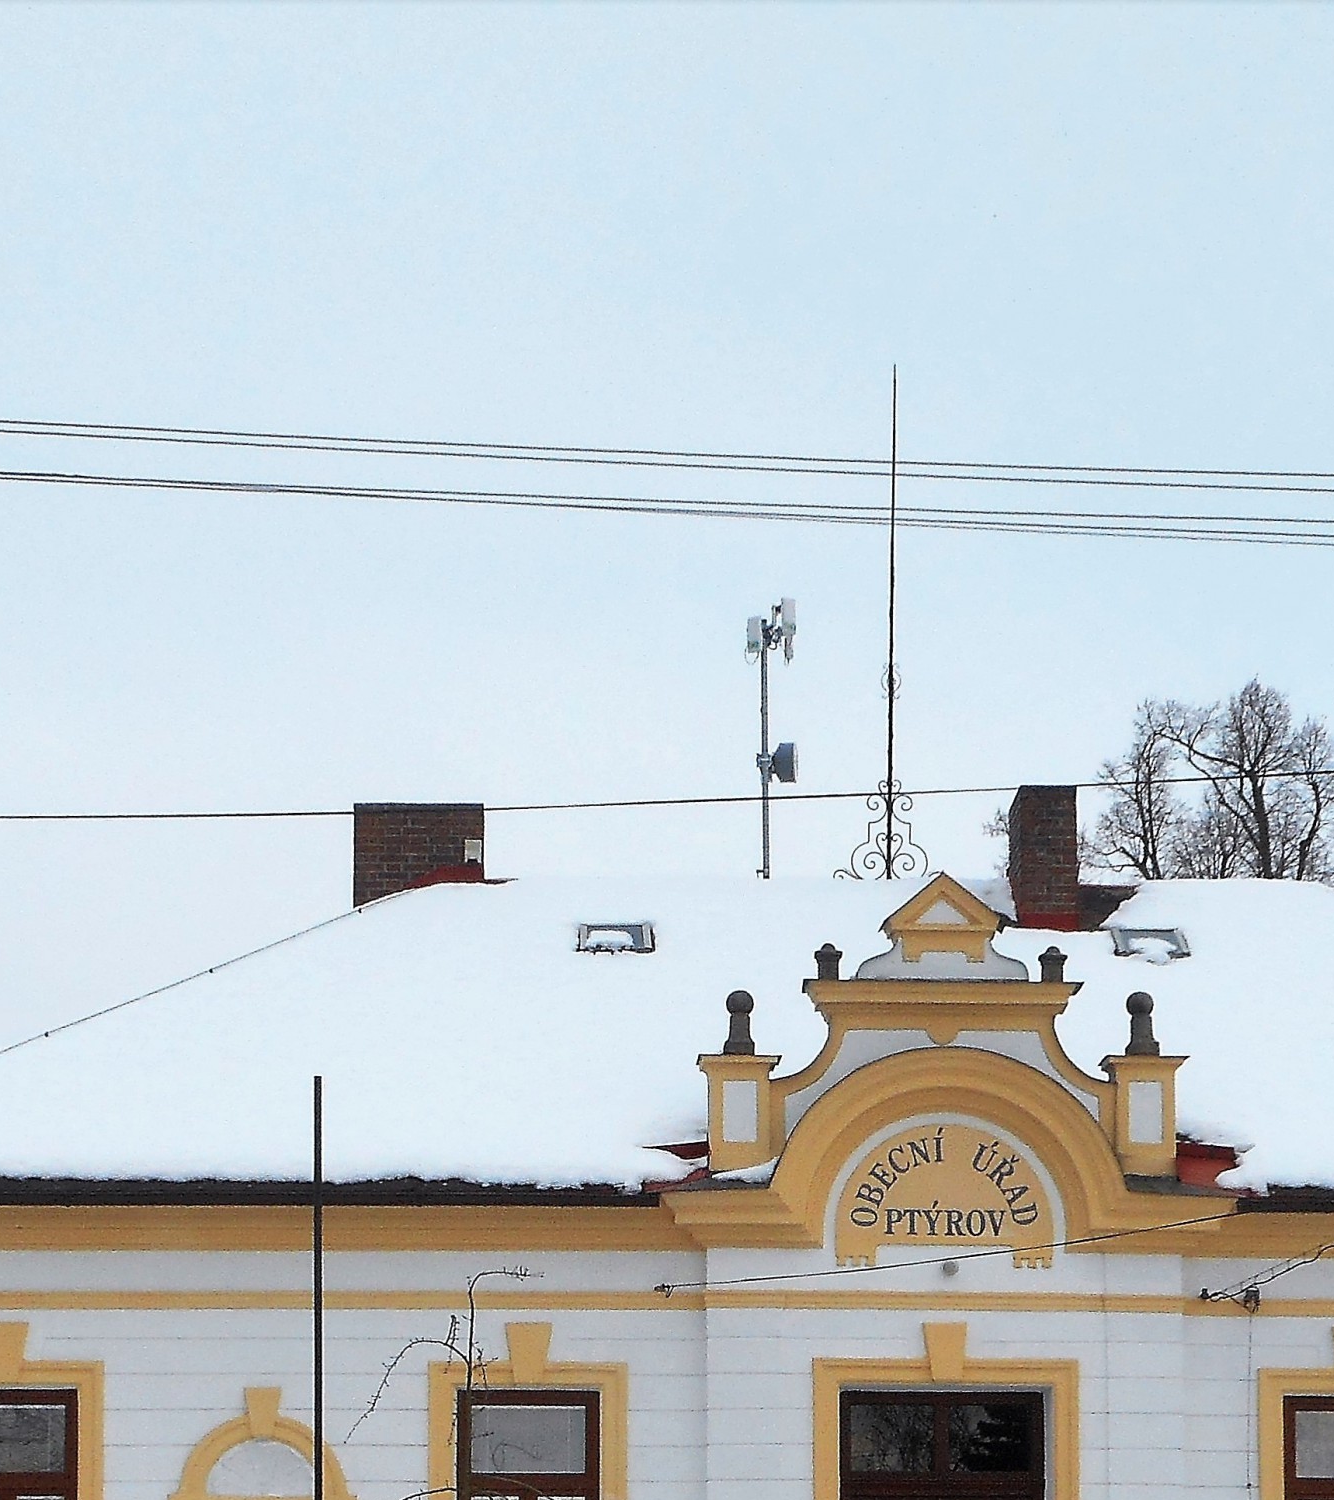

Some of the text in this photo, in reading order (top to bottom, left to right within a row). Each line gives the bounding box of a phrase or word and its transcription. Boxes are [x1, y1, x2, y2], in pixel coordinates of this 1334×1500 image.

[850, 1127, 1038, 1227] OBECNÍ ÚŘAD
[884, 1200, 1006, 1237] PTÝROV
